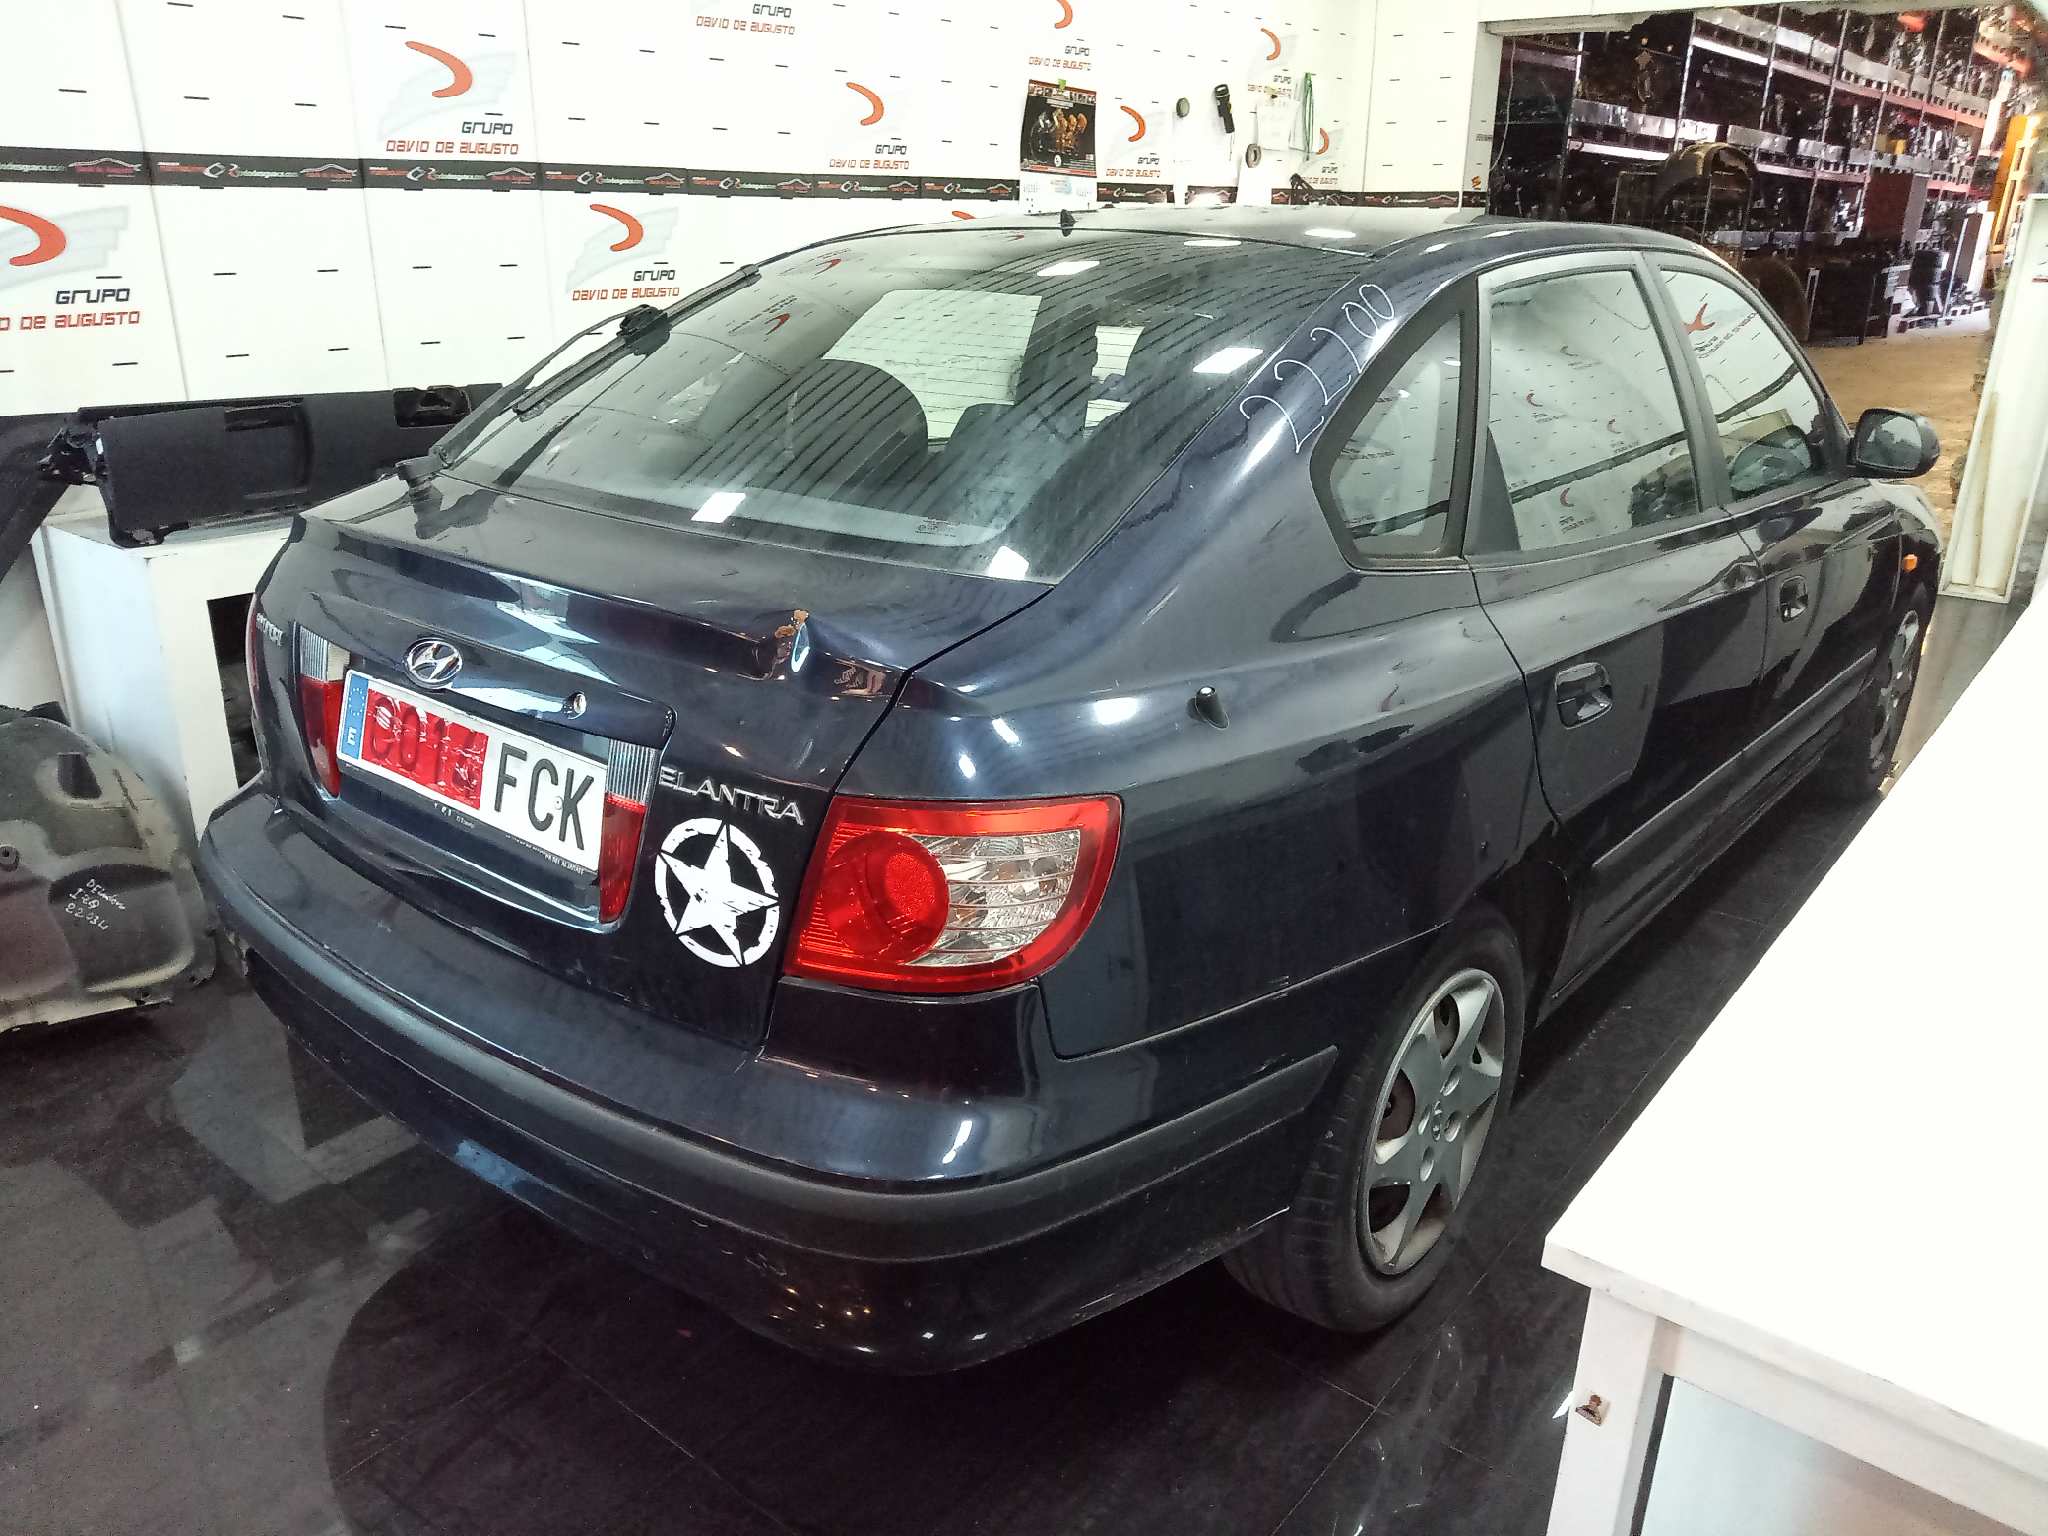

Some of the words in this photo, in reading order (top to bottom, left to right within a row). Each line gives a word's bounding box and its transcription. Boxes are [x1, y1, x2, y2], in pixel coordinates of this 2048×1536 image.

[752, 3, 792, 18] GRUPO
[696, 15, 730, 29] DAVID
[733, 19, 747, 31] DE
[750, 21, 795, 35] AUGUSTO
[461, 121, 513, 135] GRUPO
[386, 139, 430, 153] DAVID
[435, 141, 454, 153] DE
[459, 142, 519, 155] AUGUSTO
[875, 144, 907, 155] GRUPO
[633, 269, 676, 282] GRUPO
[55, 288, 131, 305] GRUPO
[572, 289, 608, 301] DAVID
[612, 288, 628, 299] DE
[631, 287, 680, 299] AUGUSTO
[20, 315, 46, 330] DE
[54, 310, 141, 328] AUGUSTO
[347, 727, 358, 746] E
[494, 742, 595, 851] FCK
[658, 765, 804, 826] ELANTRA
